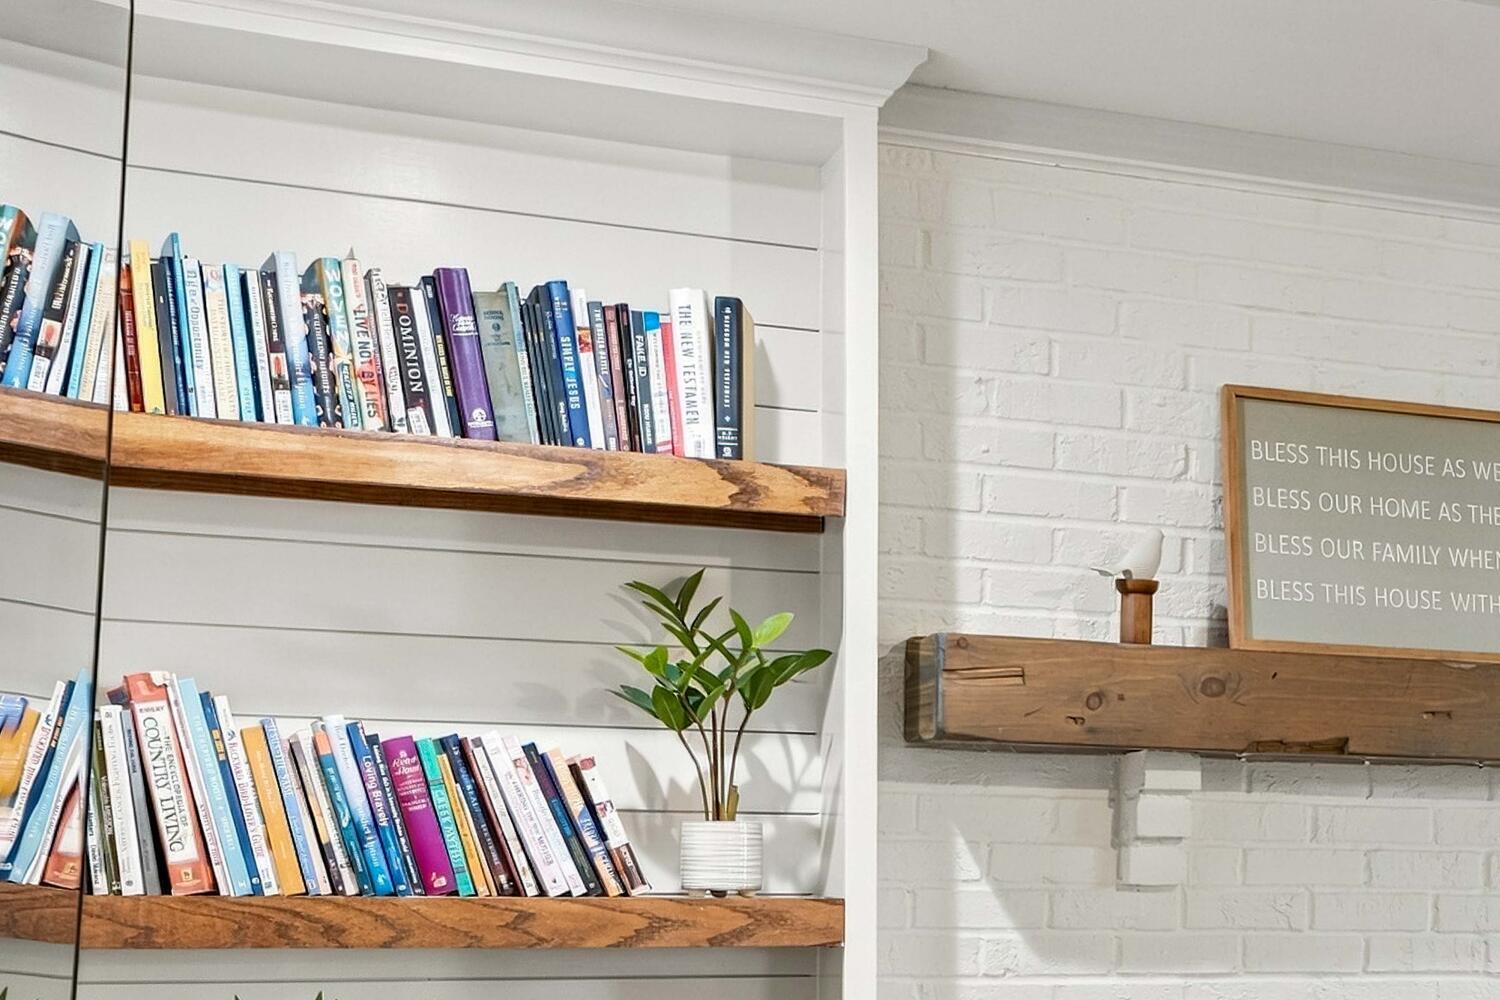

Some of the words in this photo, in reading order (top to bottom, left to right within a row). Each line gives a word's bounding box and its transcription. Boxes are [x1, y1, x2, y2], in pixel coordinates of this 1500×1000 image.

[324, 268, 350, 346] WOVEN
[352, 308, 369, 339] LIVE
[677, 304, 693, 325] THE
[188, 306, 206, 370] Opportunity
[357, 339, 372, 366] NOT
[394, 301, 425, 394] DOMINION
[559, 335, 575, 373] SIMPLY
[635, 334, 646, 363] FAKE
[678, 331, 695, 359] NEW
[361, 369, 375, 387] BY
[565, 375, 580, 409] JESUS
[679, 363, 702, 427] TESTAMEN
[364, 390, 379, 418] LIES
[1250, 439, 1309, 464] BLESS
[1315, 446, 1360, 470] THIS
[1368, 451, 1435, 476] HOUSE
[1442, 457, 1466, 479] AS
[1253, 487, 1310, 511] BLESS
[1319, 493, 1362, 515] OUR
[1370, 497, 1432, 520] HOME
[1438, 503, 1462, 524] AS
[1255, 532, 1312, 558] BLESS
[1321, 538, 1364, 561] OUR
[1373, 542, 1440, 566] FAMILY
[1256, 579, 1314, 602] BLESS
[1321, 583, 1366, 606] THIS
[1375, 588, 1442, 611] HOUSE
[162, 735, 172, 751] THE
[451, 745, 460, 755] IS
[140, 715, 173, 793] COUNTRY
[157, 795, 186, 853] LIVING
[165, 753, 186, 813] ENCYCLOPEDIA
[359, 753, 379, 789] Loving
[369, 789, 390, 827] Bravely
[179, 814, 188, 827] OF
[433, 787, 451, 823] GREEK
[443, 823, 462, 864] MYTHS
